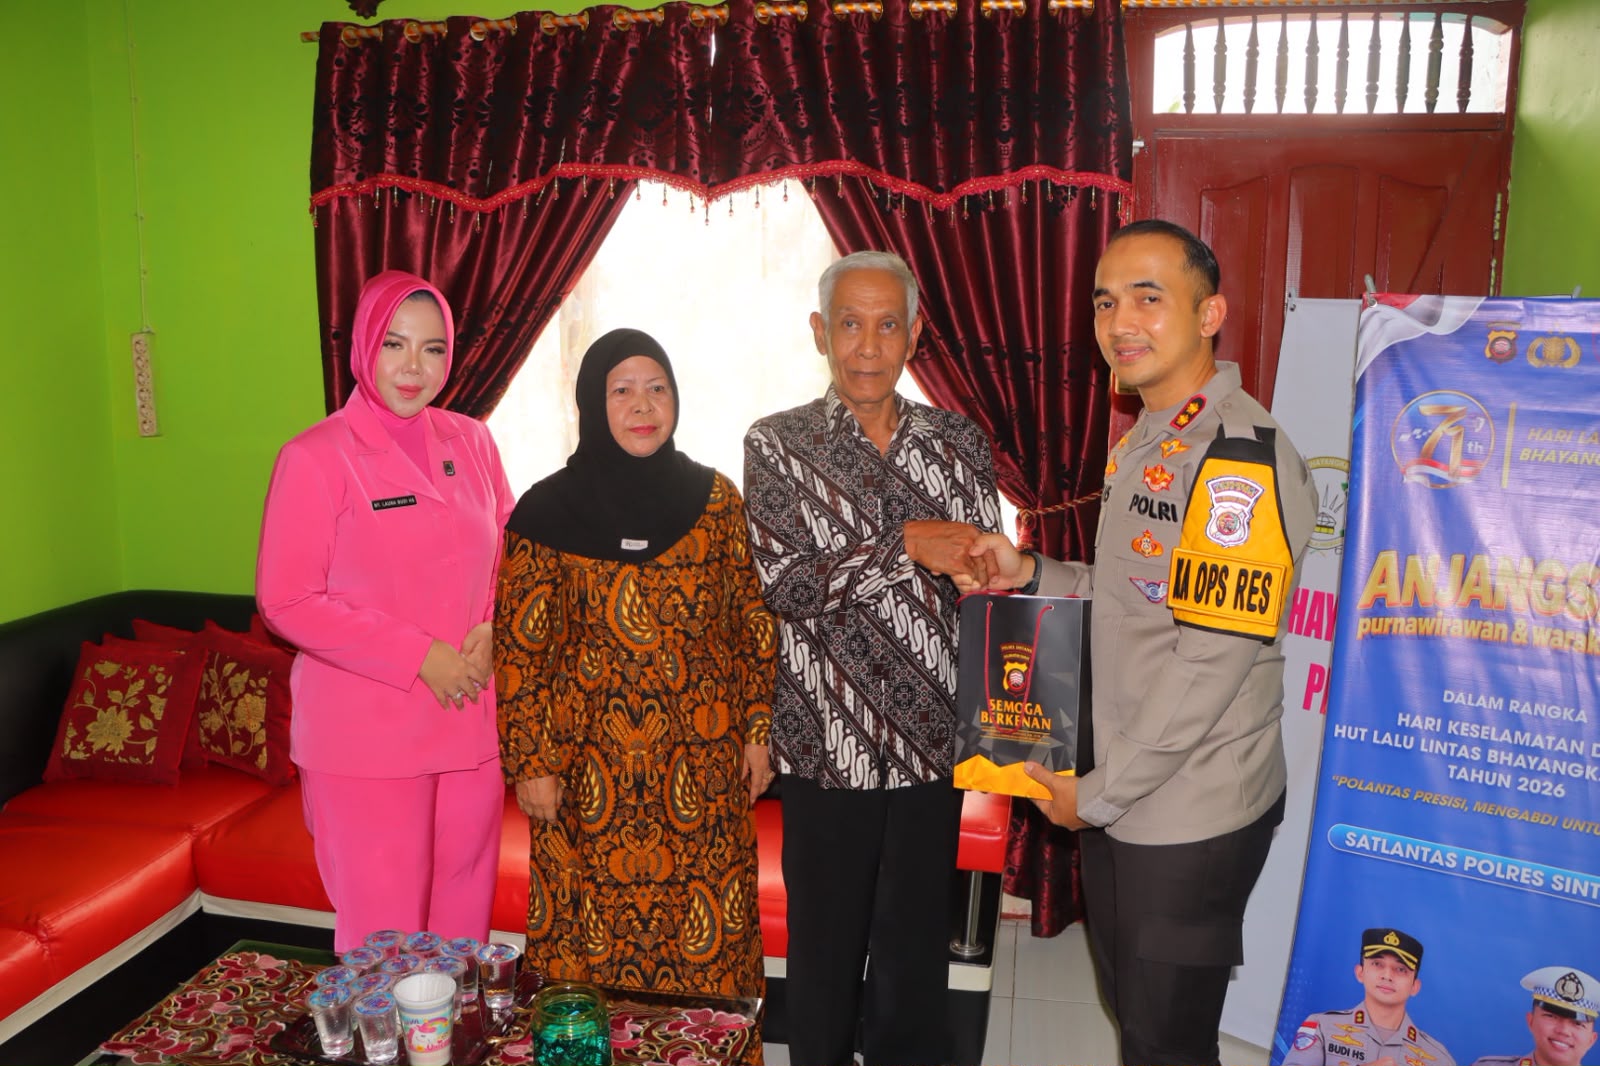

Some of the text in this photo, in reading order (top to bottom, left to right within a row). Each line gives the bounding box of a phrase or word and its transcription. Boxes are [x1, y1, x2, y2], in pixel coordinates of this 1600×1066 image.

[1527, 427, 1573, 443] HARI
[1129, 493, 1178, 523] POLRI
[1194, 561, 1229, 608] OPS
[1233, 568, 1273, 615] RES
[1357, 549, 1600, 622] ANJANGS
[1356, 611, 1508, 643] purnawirawan
[1511, 617, 1529, 645] &
[989, 698, 1044, 716] SEMOGA
[1443, 690, 1588, 724] DALAM RANGKA
[1397, 712, 1442, 732] HARI
[1447, 720, 1585, 755] KESELAMATAN
[1334, 724, 1600, 782] HUT LALU LINTAS BHAYANGK
[1448, 764, 1566, 798] TAHUN 2026
[1413, 790, 1469, 812] PRESISI,
[1473, 801, 1559, 827] MENGABDI
[1344, 831, 1600, 900] SATLANTAS POLRES SINT
[1328, 1043, 1366, 1061] BUDI HS
